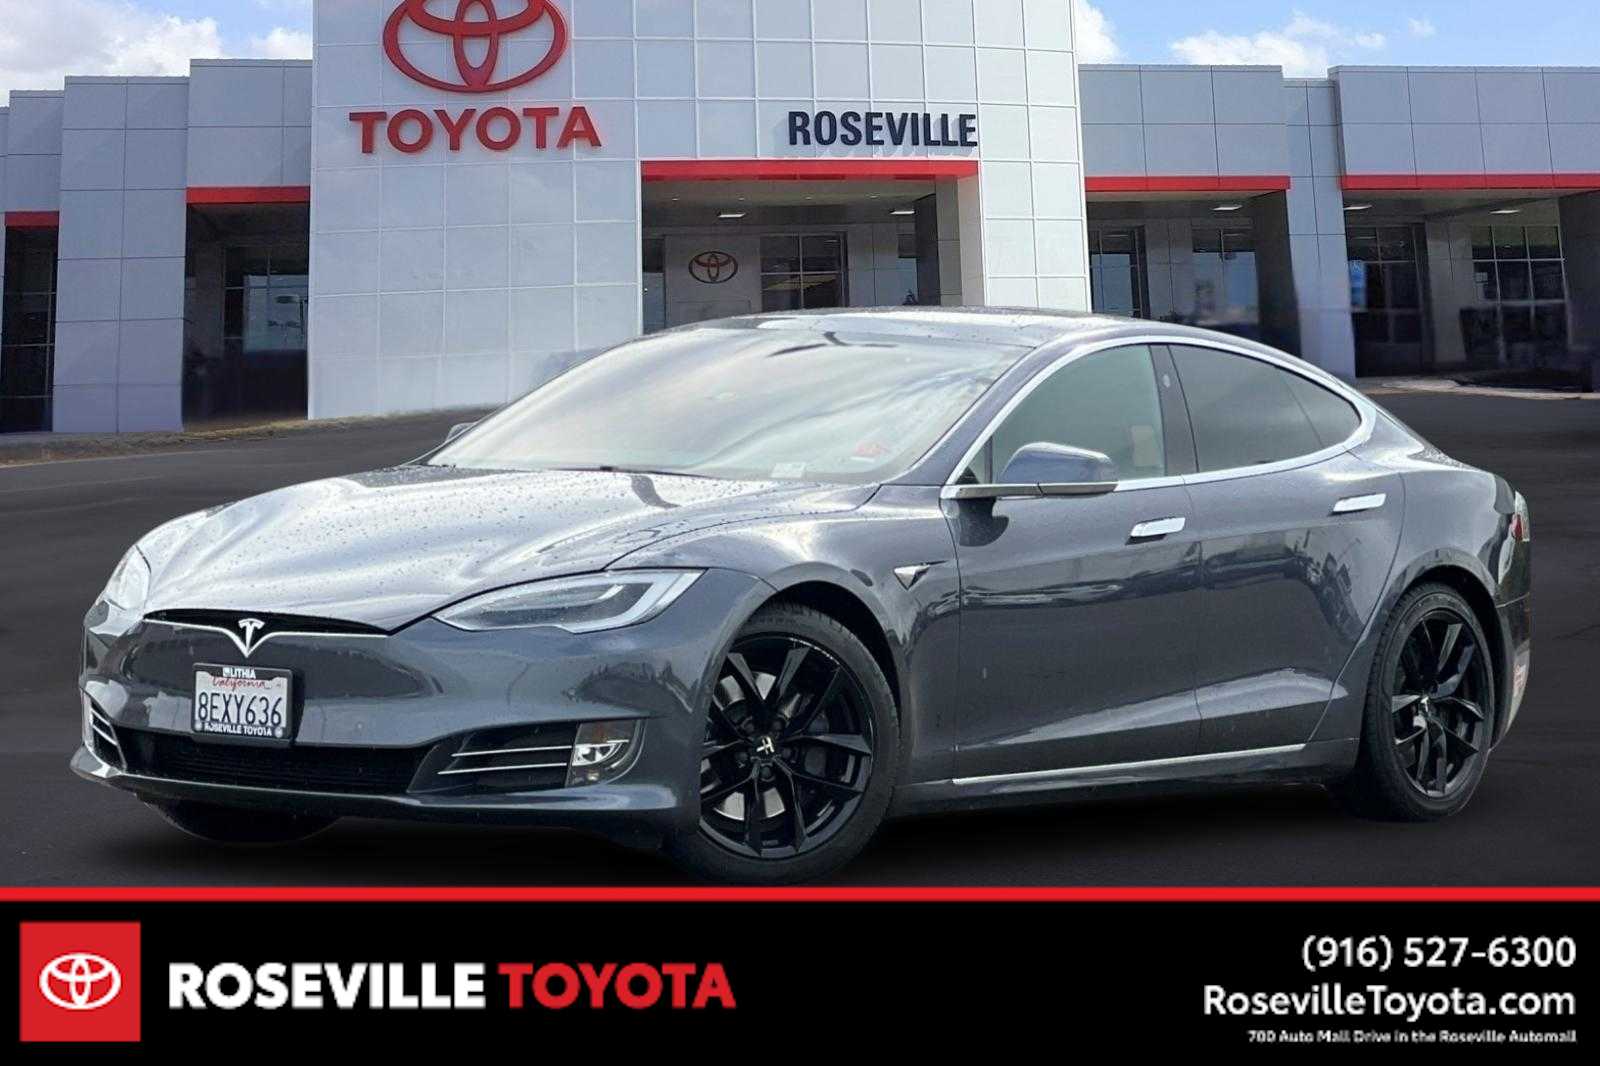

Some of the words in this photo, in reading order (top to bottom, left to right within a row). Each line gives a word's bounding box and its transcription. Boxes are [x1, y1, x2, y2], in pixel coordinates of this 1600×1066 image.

[350, 106, 603, 154] TOYOTA
[788, 111, 978, 147] ROSEVILLE
[199, 692, 282, 726] 8EXY636
[204, 722, 242, 734] ROSEVILLE
[243, 726, 272, 736] TOYOTA
